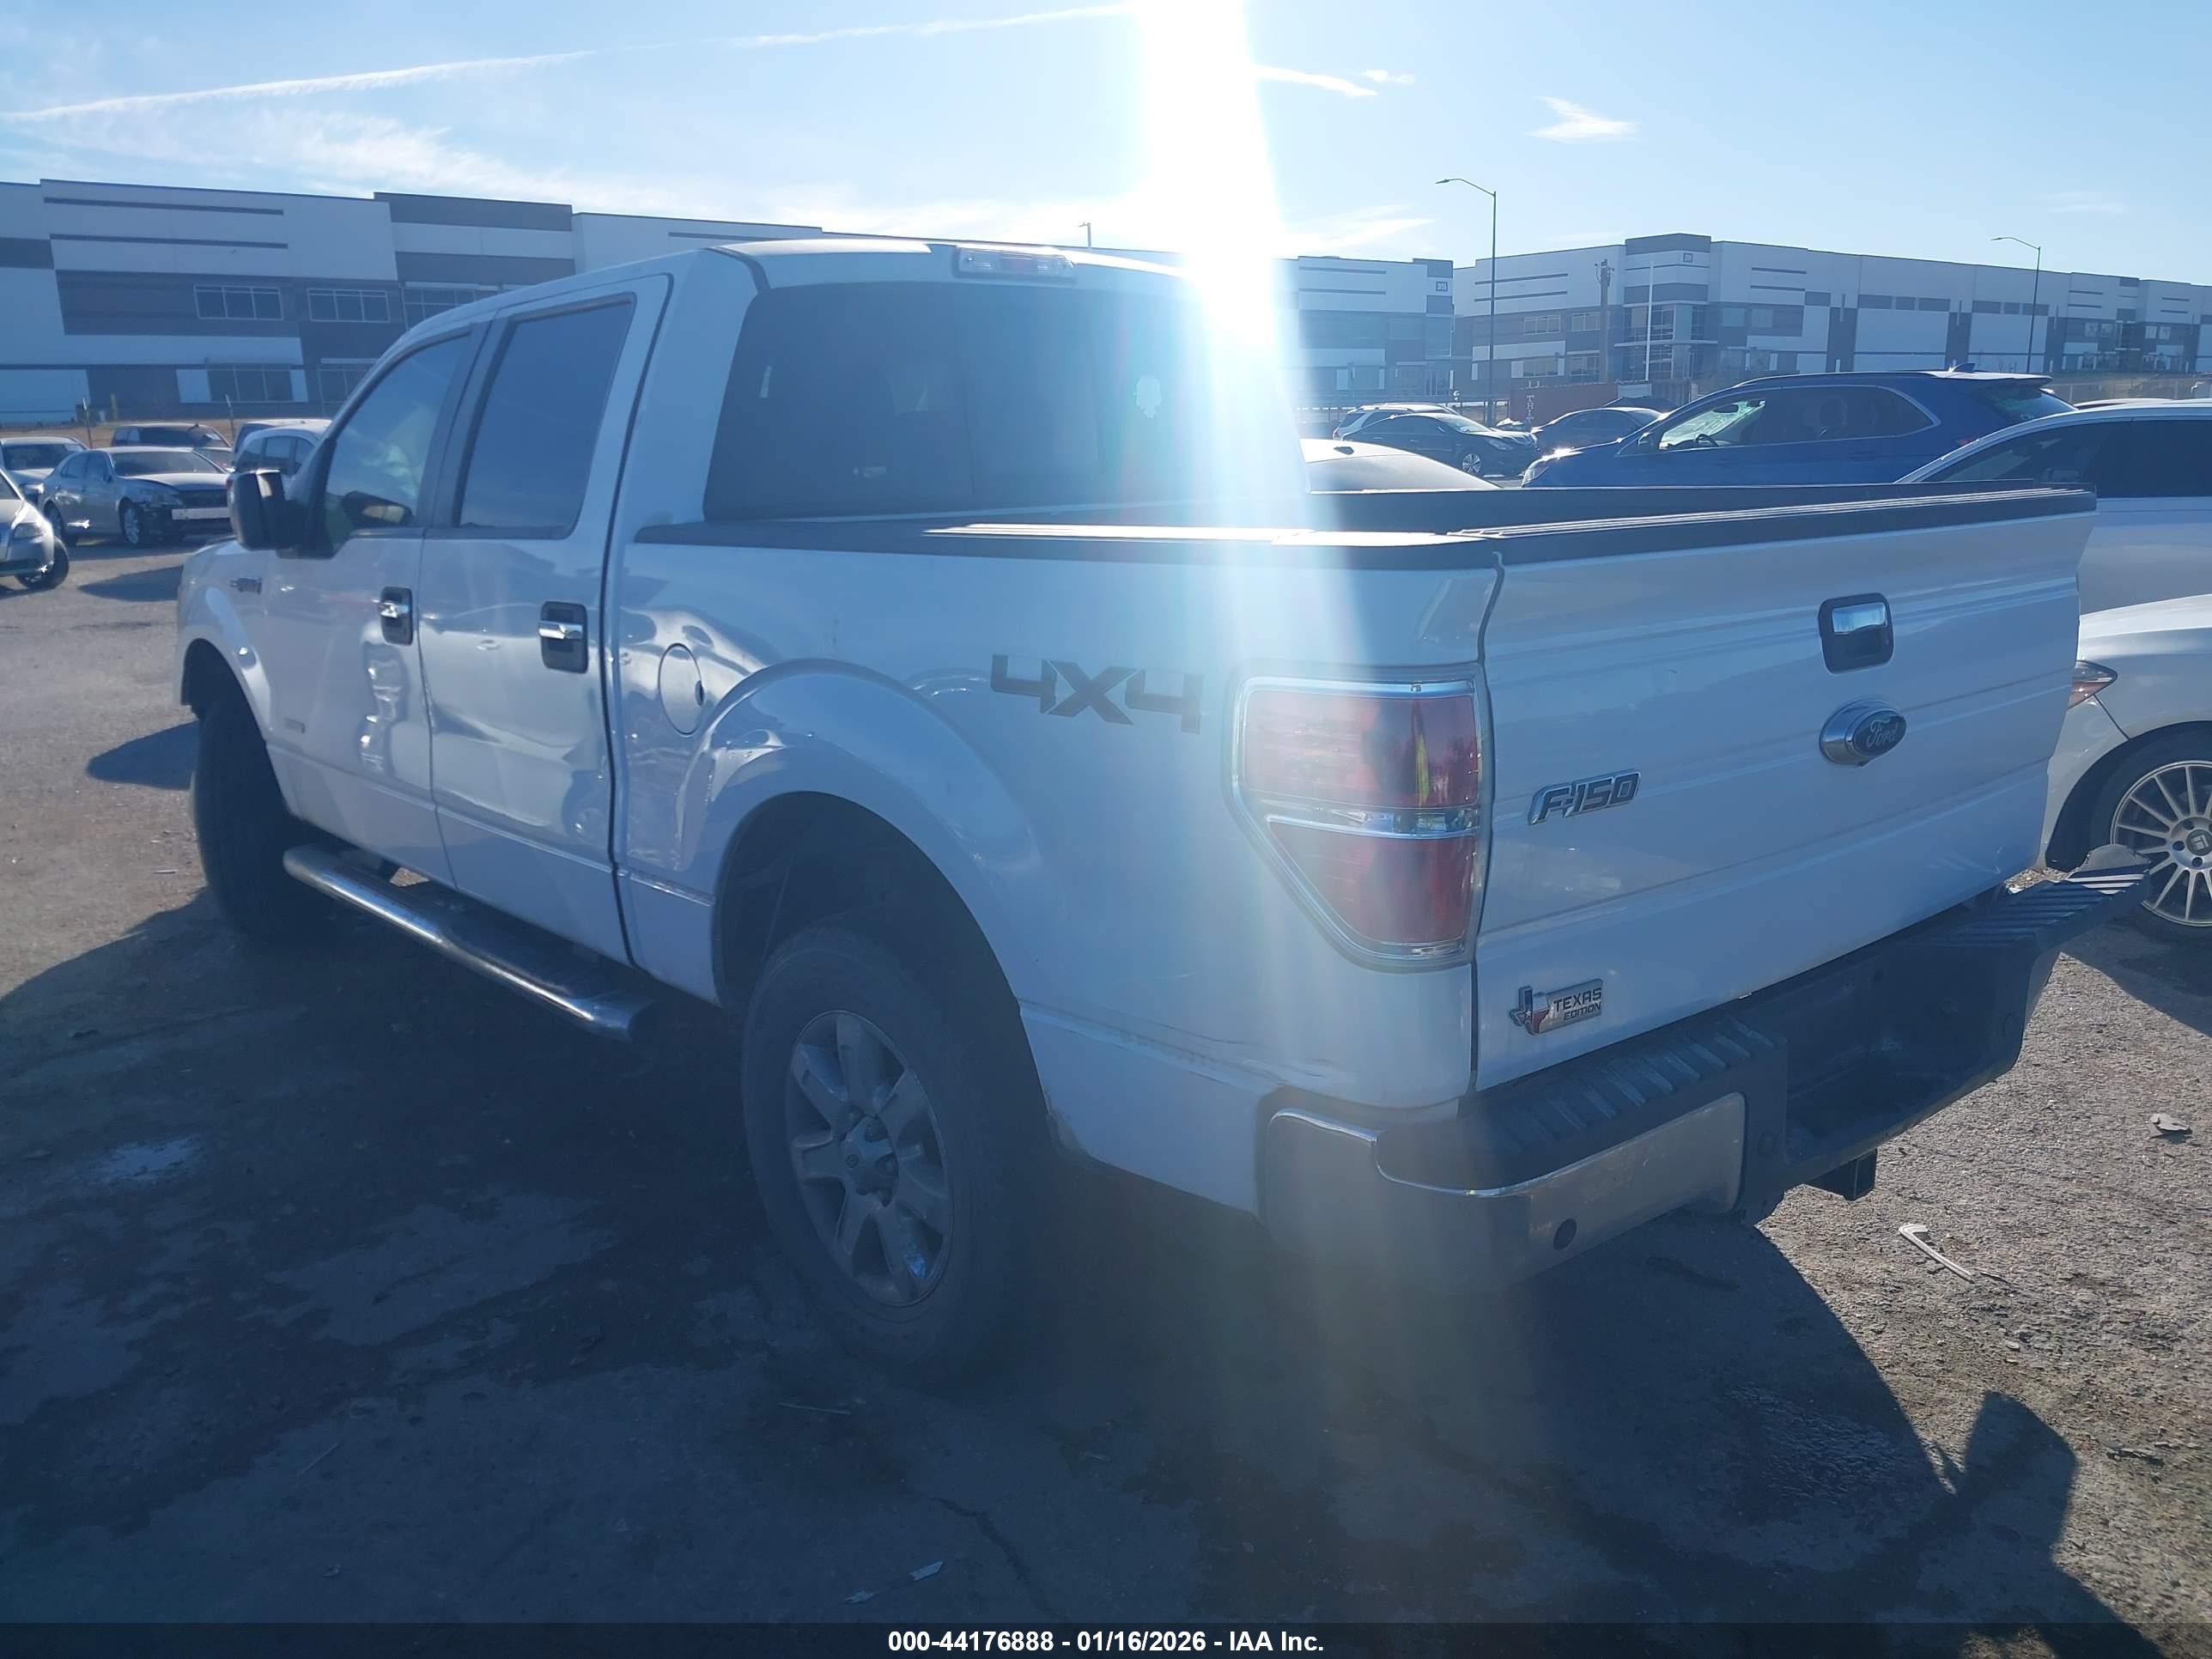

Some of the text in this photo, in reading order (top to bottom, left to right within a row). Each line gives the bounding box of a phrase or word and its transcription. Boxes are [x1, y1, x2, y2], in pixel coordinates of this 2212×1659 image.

[1528, 769, 1641, 824] F-150
[1553, 987, 1602, 1012] TEXAS
[1564, 1002, 1602, 1021] EDITION
